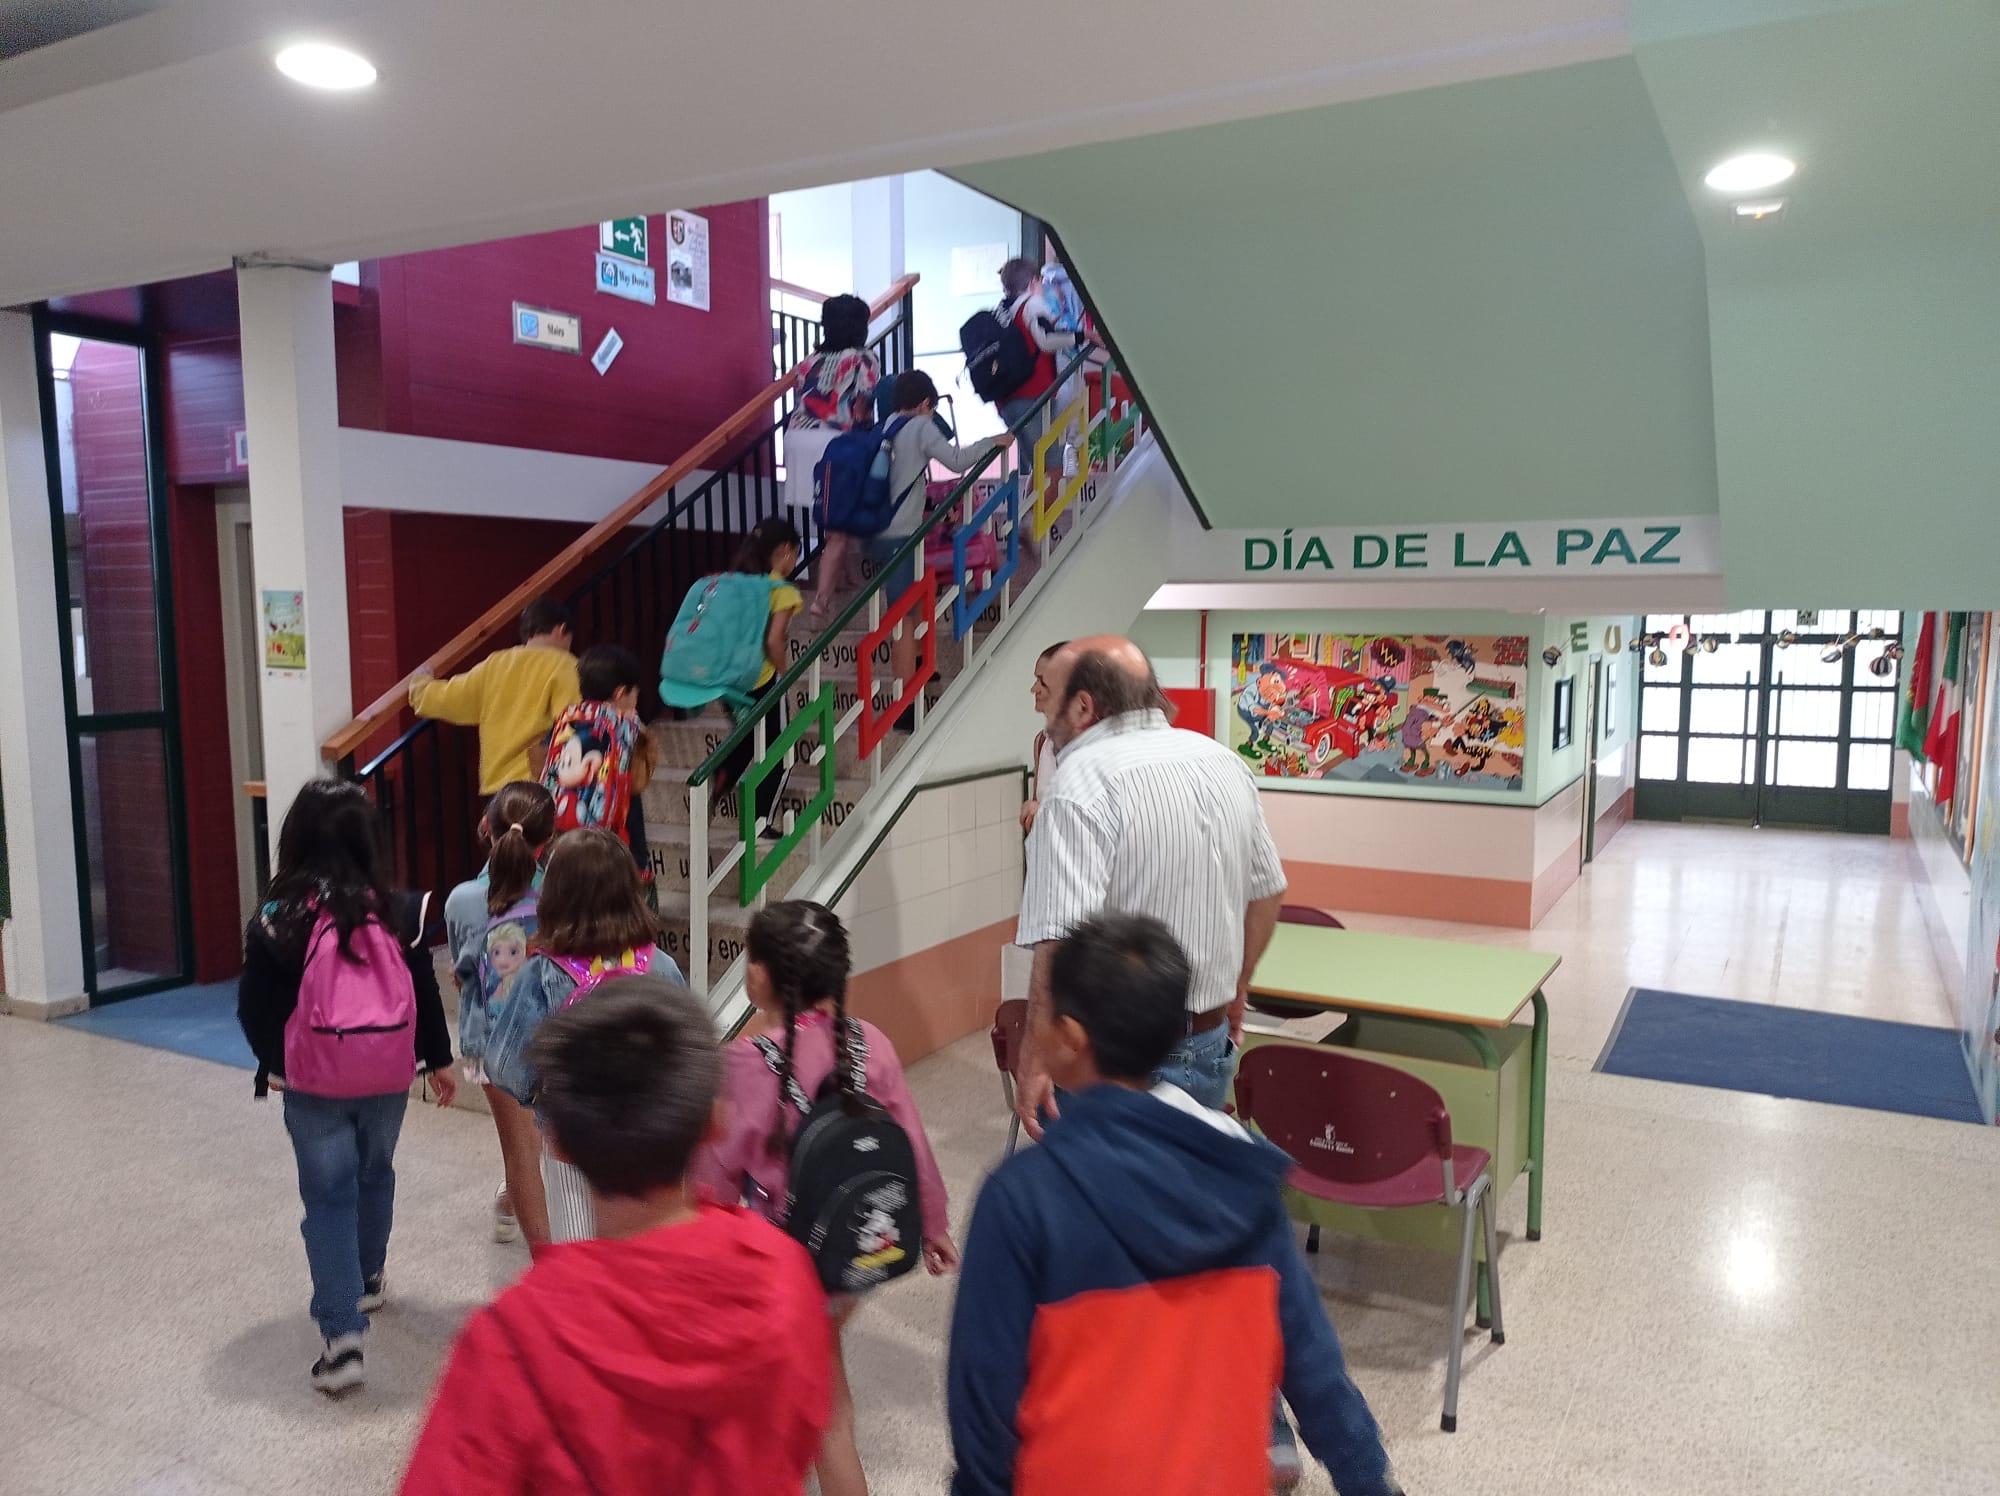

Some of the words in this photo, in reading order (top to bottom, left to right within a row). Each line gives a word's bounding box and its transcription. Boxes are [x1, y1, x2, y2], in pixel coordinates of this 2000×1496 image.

[1244, 528, 1335, 571] DÍA
[1353, 533, 1428, 569] DE
[1454, 531, 1532, 567] LA
[1556, 526, 1682, 566] PAZ
